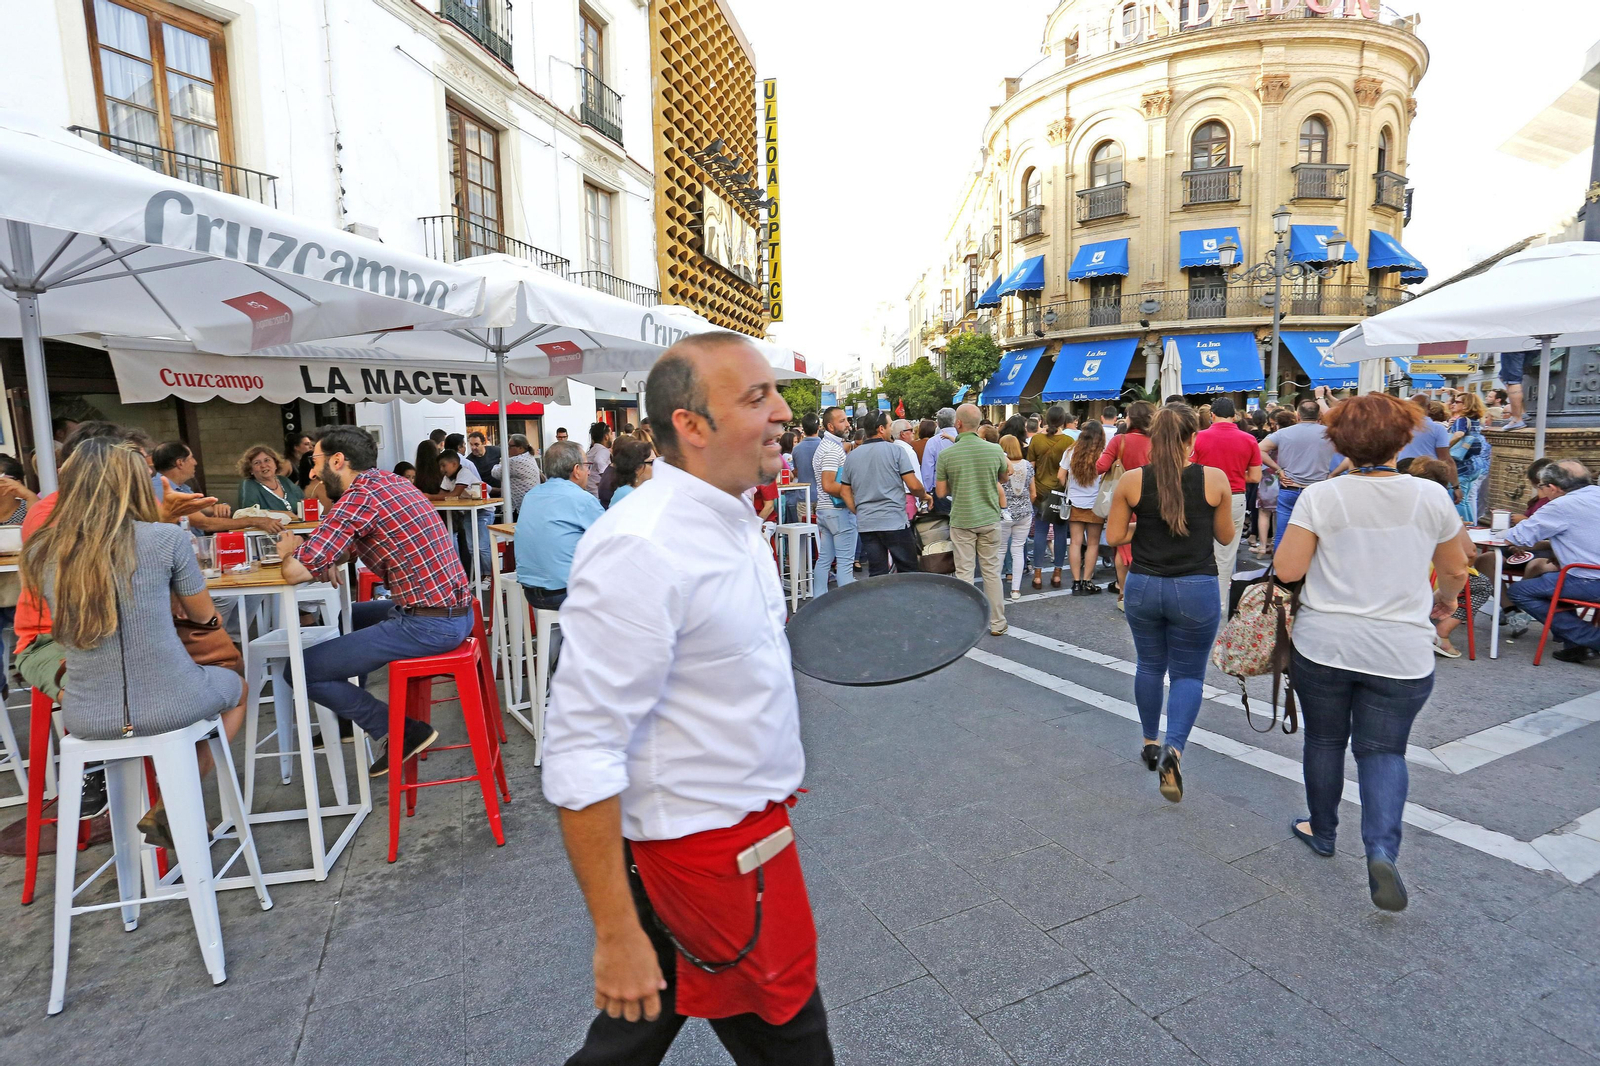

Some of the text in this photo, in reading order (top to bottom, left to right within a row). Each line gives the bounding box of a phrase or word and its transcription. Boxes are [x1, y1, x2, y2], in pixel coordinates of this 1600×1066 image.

[144, 190, 450, 311] Cruzcampo
[764, 83, 782, 319] ULLOA OPTICO
[160, 365, 554, 398] Cruzcampo LA MACETA Cruzcampo
